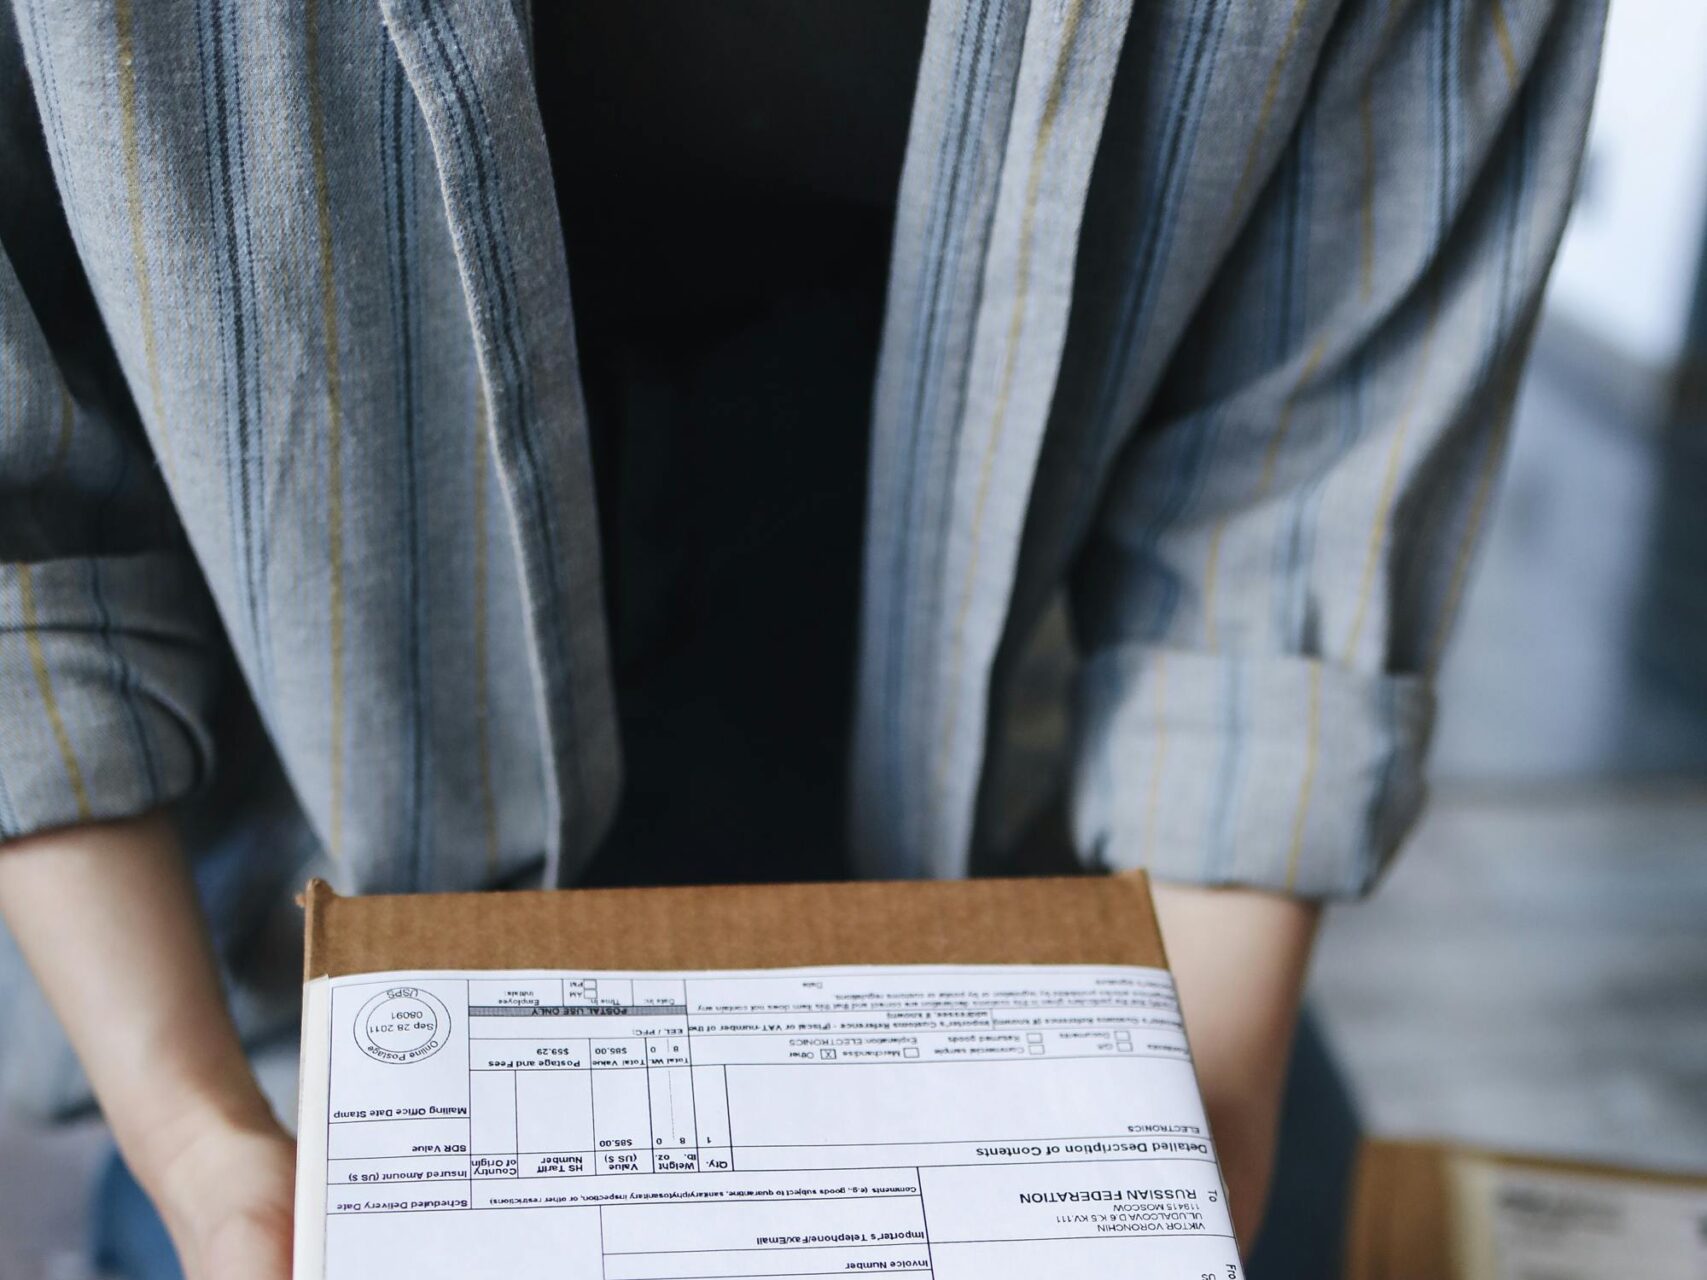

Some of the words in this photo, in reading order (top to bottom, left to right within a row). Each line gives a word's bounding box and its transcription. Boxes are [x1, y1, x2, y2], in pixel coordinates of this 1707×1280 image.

[386, 988, 419, 999] USPS
[391, 1011, 423, 1020] 08091
[531, 1007, 559, 1016] ONLY
[562, 1007, 584, 1016] USE
[586, 1007, 628, 1015] POSTAL
[369, 1025, 394, 1033] 2011
[414, 1022, 434, 1032] Sep
[367, 1045, 406, 1062] Postage
[409, 1040, 439, 1058] Online
[595, 1046, 628, 1055] $85.00
[539, 1058, 580, 1067] Postage
[334, 1109, 366, 1120] Stamp
[369, 1110, 393, 1118] Date
[396, 1108, 426, 1117] Office
[428, 1106, 467, 1116] Mailing
[1127, 1125, 1200, 1134] ELECTRONICS
[599, 1139, 633, 1148] $85.00
[1066, 1141, 1147, 1155] Description
[1152, 1142, 1207, 1154] Detailed
[412, 1146, 442, 1154] Value
[445, 1145, 467, 1154] SDR
[976, 1146, 1041, 1157] Contents
[1045, 1146, 1060, 1156] of
[541, 1157, 582, 1165] Number
[618, 1154, 638, 1163] (US
[471, 1159, 503, 1168] Origin
[568, 1164, 583, 1172] HS
[608, 1163, 638, 1171] Value
[658, 1160, 694, 1170] Weight
[706, 1160, 728, 1169] Qty.
[474, 1166, 516, 1176] Country
[537, 1165, 566, 1174] Tariff
[361, 1171, 380, 1181] (US
[382, 1171, 424, 1180] Amount
[426, 1170, 467, 1179] Insured
[786, 1187, 816, 1195] subject
[820, 1187, 846, 1195] goods
[1126, 1189, 1196, 1200] RUSSIAN
[490, 1197, 542, 1205] restrictions)
[1020, 1190, 1122, 1203] FEDERATION
[337, 1202, 362, 1211] Date
[364, 1200, 408, 1210] Delivery
[411, 1199, 468, 1208] Scheduled
[1097, 1223, 1164, 1232] VORONCHIN
[1166, 1223, 1205, 1231] VIKTOR
[756, 1233, 868, 1244] Telephone/Fax/Email
[871, 1231, 924, 1241] Importer's
[846, 1262, 887, 1270] Number
[890, 1260, 928, 1269] Invoice
